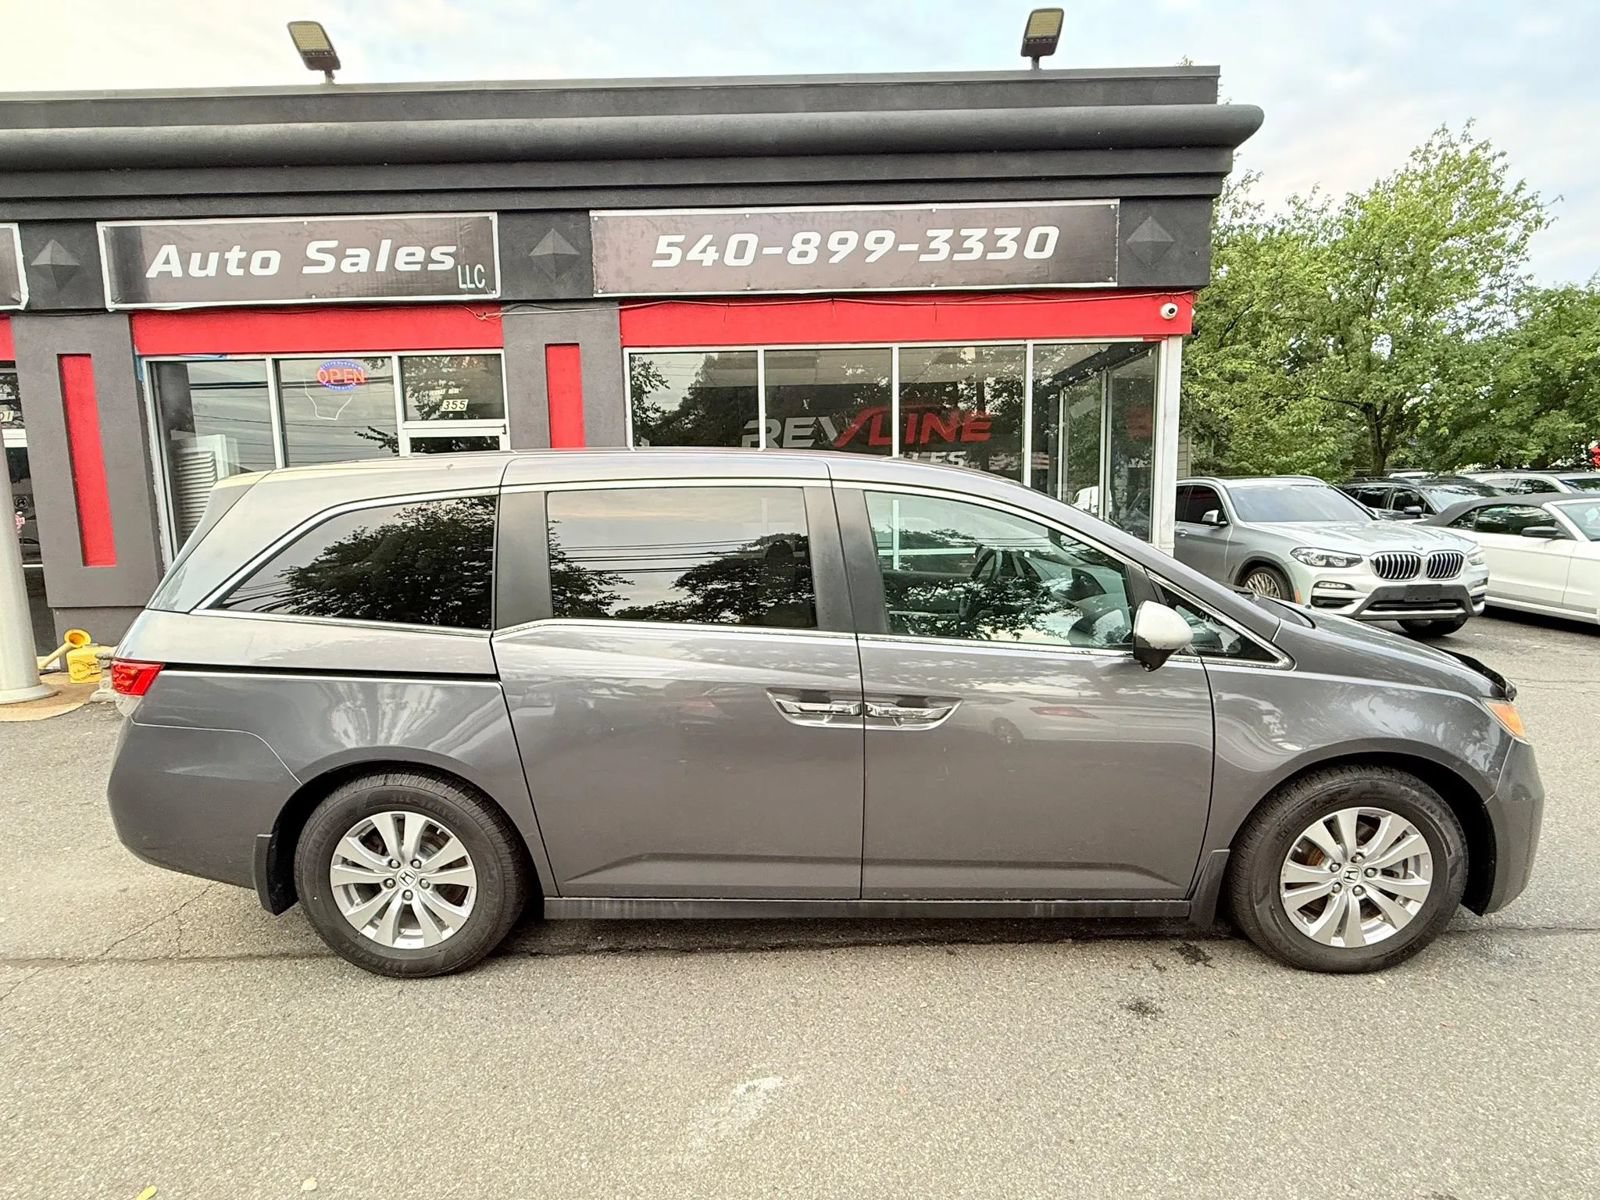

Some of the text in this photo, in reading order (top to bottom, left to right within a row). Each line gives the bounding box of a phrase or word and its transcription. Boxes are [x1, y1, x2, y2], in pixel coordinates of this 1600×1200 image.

[651, 225, 1060, 267] 540-899-3330
[145, 239, 486, 289] Auto Sales LLC
[316, 368, 365, 384] OPEN
[443, 400, 466, 410] 355
